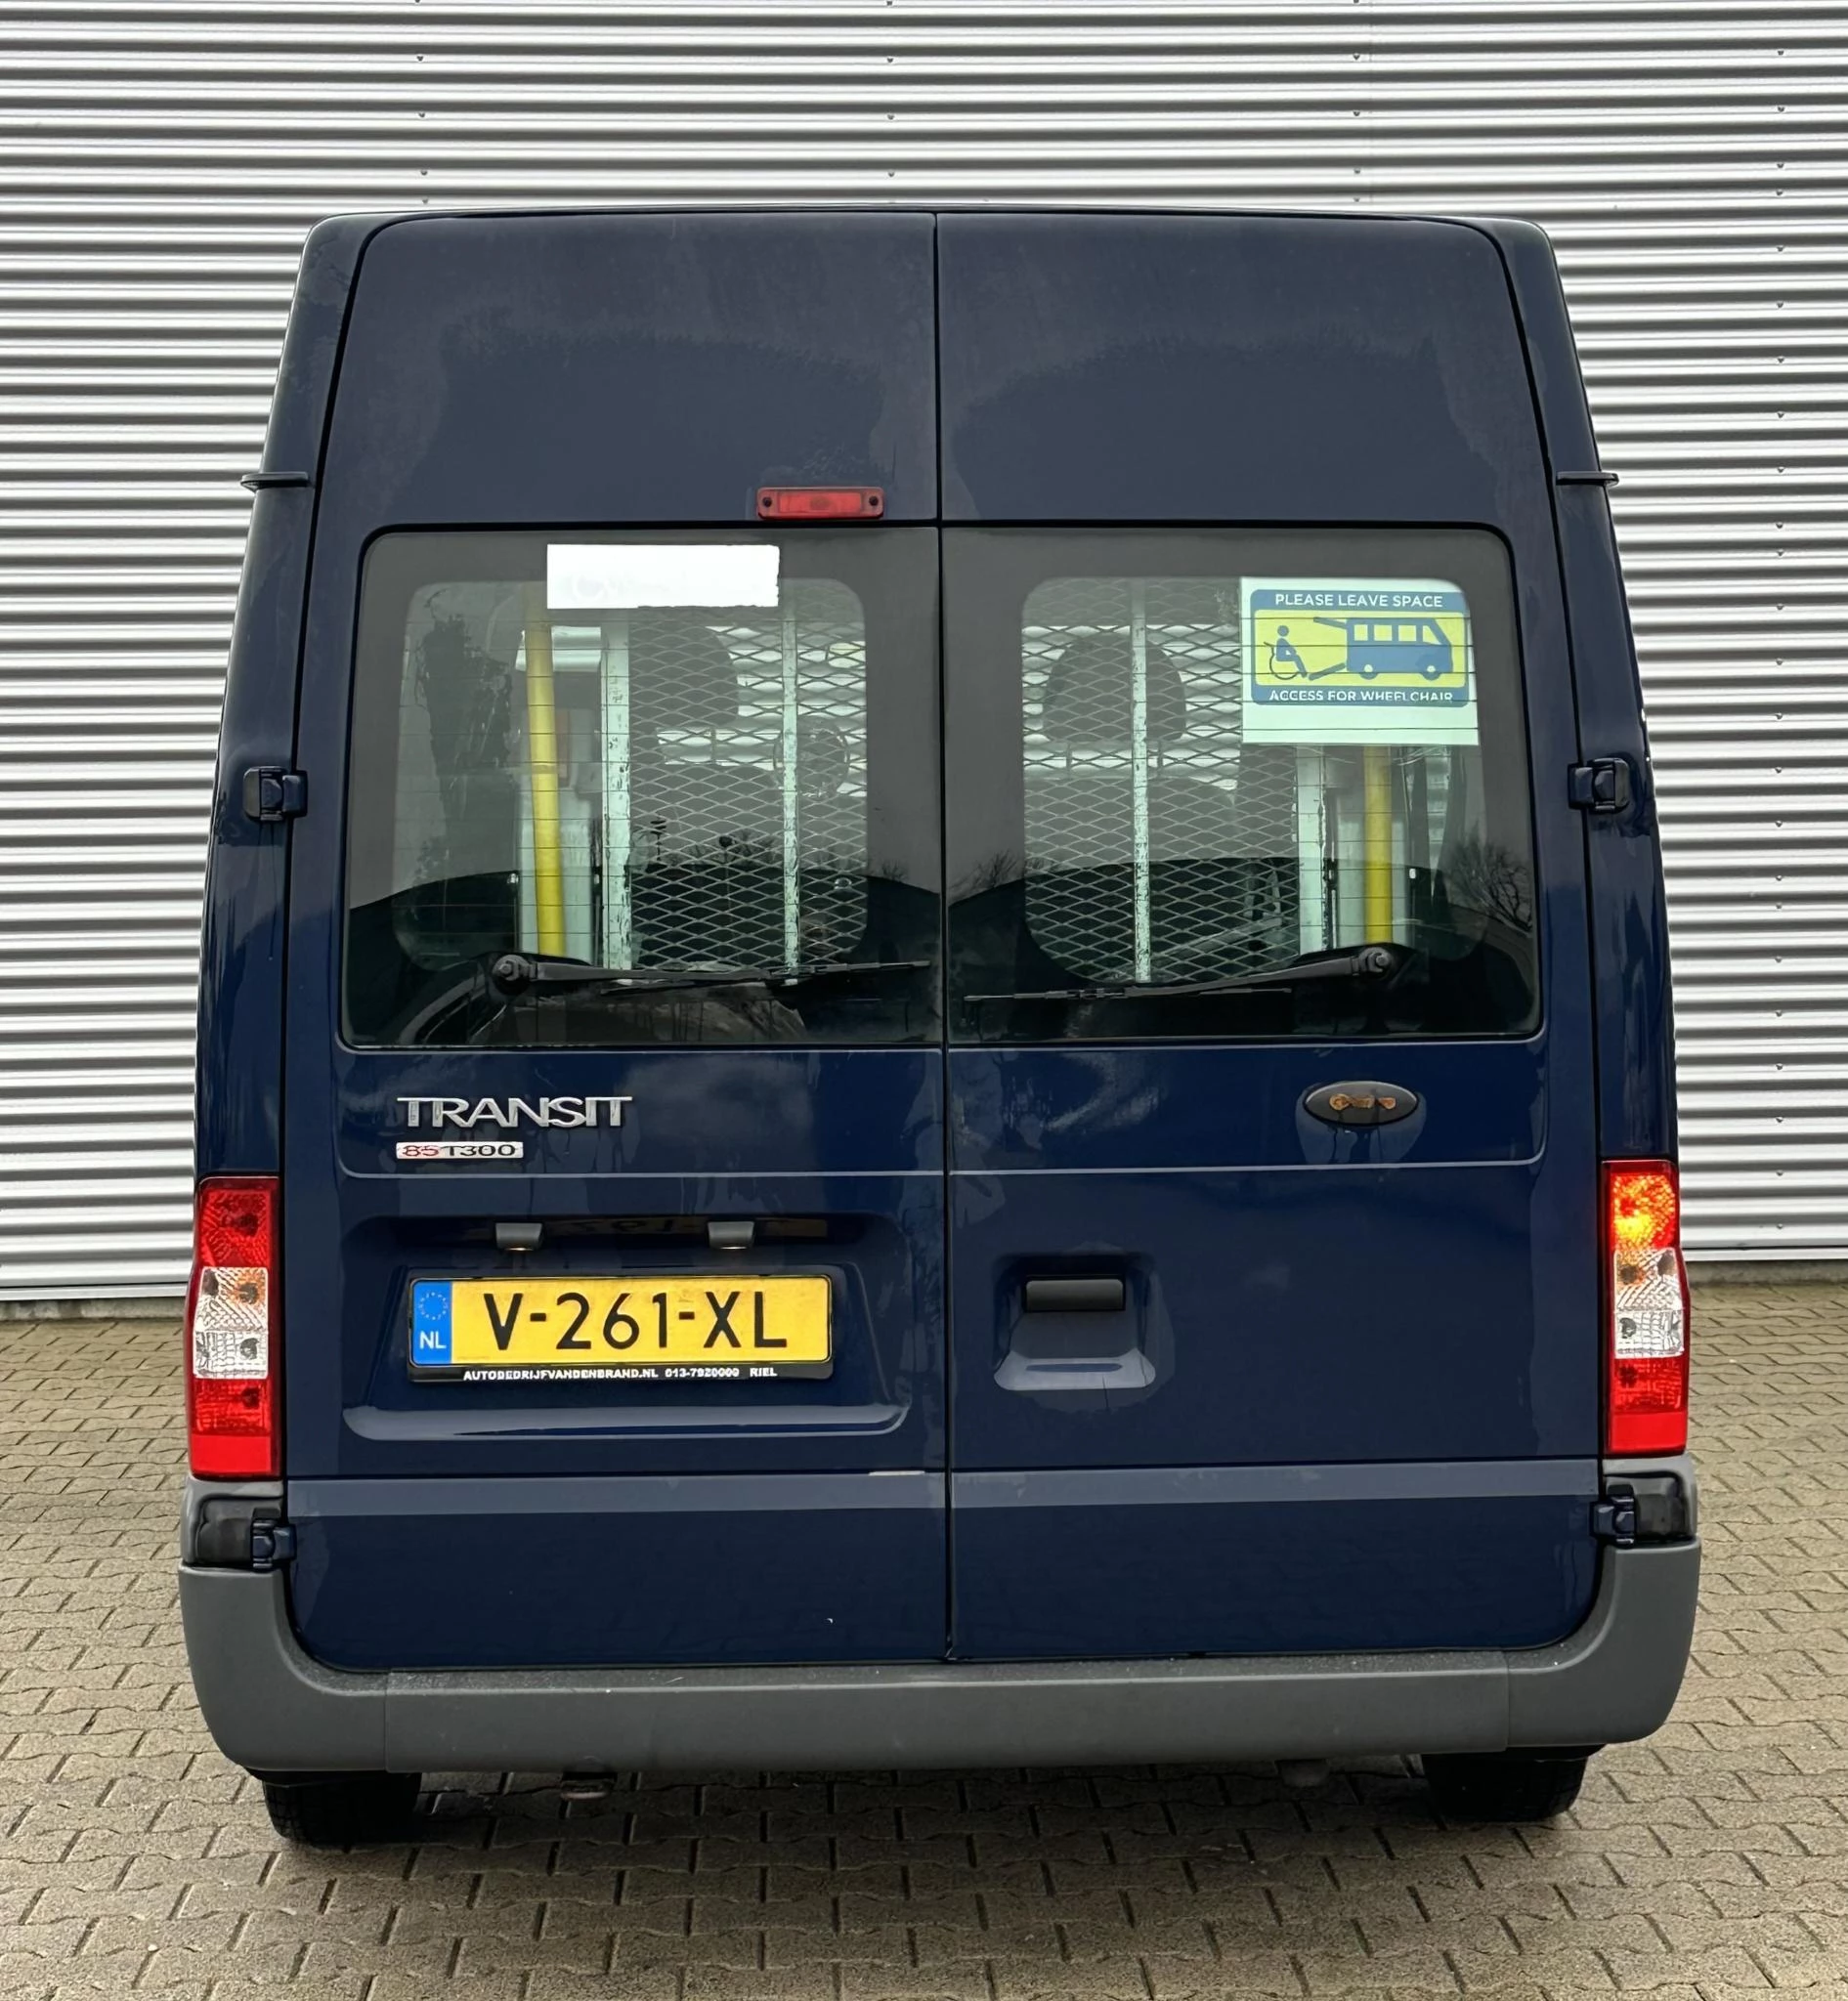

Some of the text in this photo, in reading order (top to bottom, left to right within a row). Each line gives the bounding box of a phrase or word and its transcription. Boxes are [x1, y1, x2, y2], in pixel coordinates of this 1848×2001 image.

[1275, 593, 1443, 608] PLEASE LEAVE SPACE
[1269, 690, 1324, 702] ACCESS
[1327, 691, 1357, 702] FOR
[397, 1096, 632, 1128] TRANSIT
[484, 1291, 788, 1350] V-261-XL
[419, 1332, 447, 1349] NL
[750, 1368, 778, 1377] RIEL
